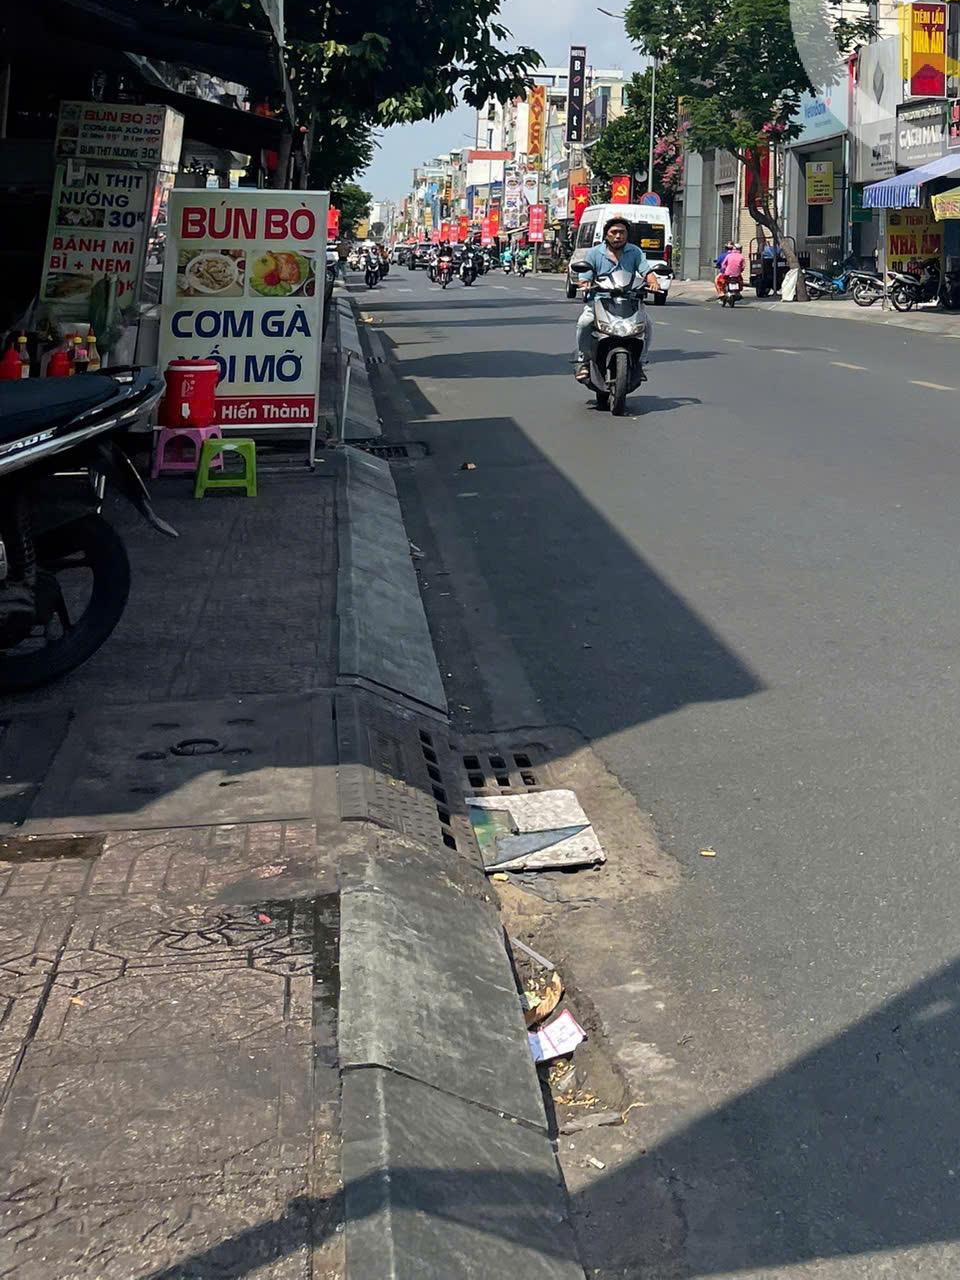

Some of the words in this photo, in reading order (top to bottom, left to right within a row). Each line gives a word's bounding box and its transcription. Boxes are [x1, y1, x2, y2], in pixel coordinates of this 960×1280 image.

[106, 174, 143, 192] THỊT
[60, 190, 130, 208] NƯỚNG
[180, 200, 258, 240] BÚN
[264, 203, 316, 241] BÒ
[53, 235, 106, 253] BÁNH
[113, 237, 135, 254] MÌ
[50, 252, 68, 270] BÌ
[91, 258, 131, 273] NEM
[171, 310, 254, 338] CƠM
[261, 304, 311, 338] GÀ
[244, 350, 303, 384] MỠ
[222, 401, 257, 420] Hiến
[262, 402, 309, 420] Thành
